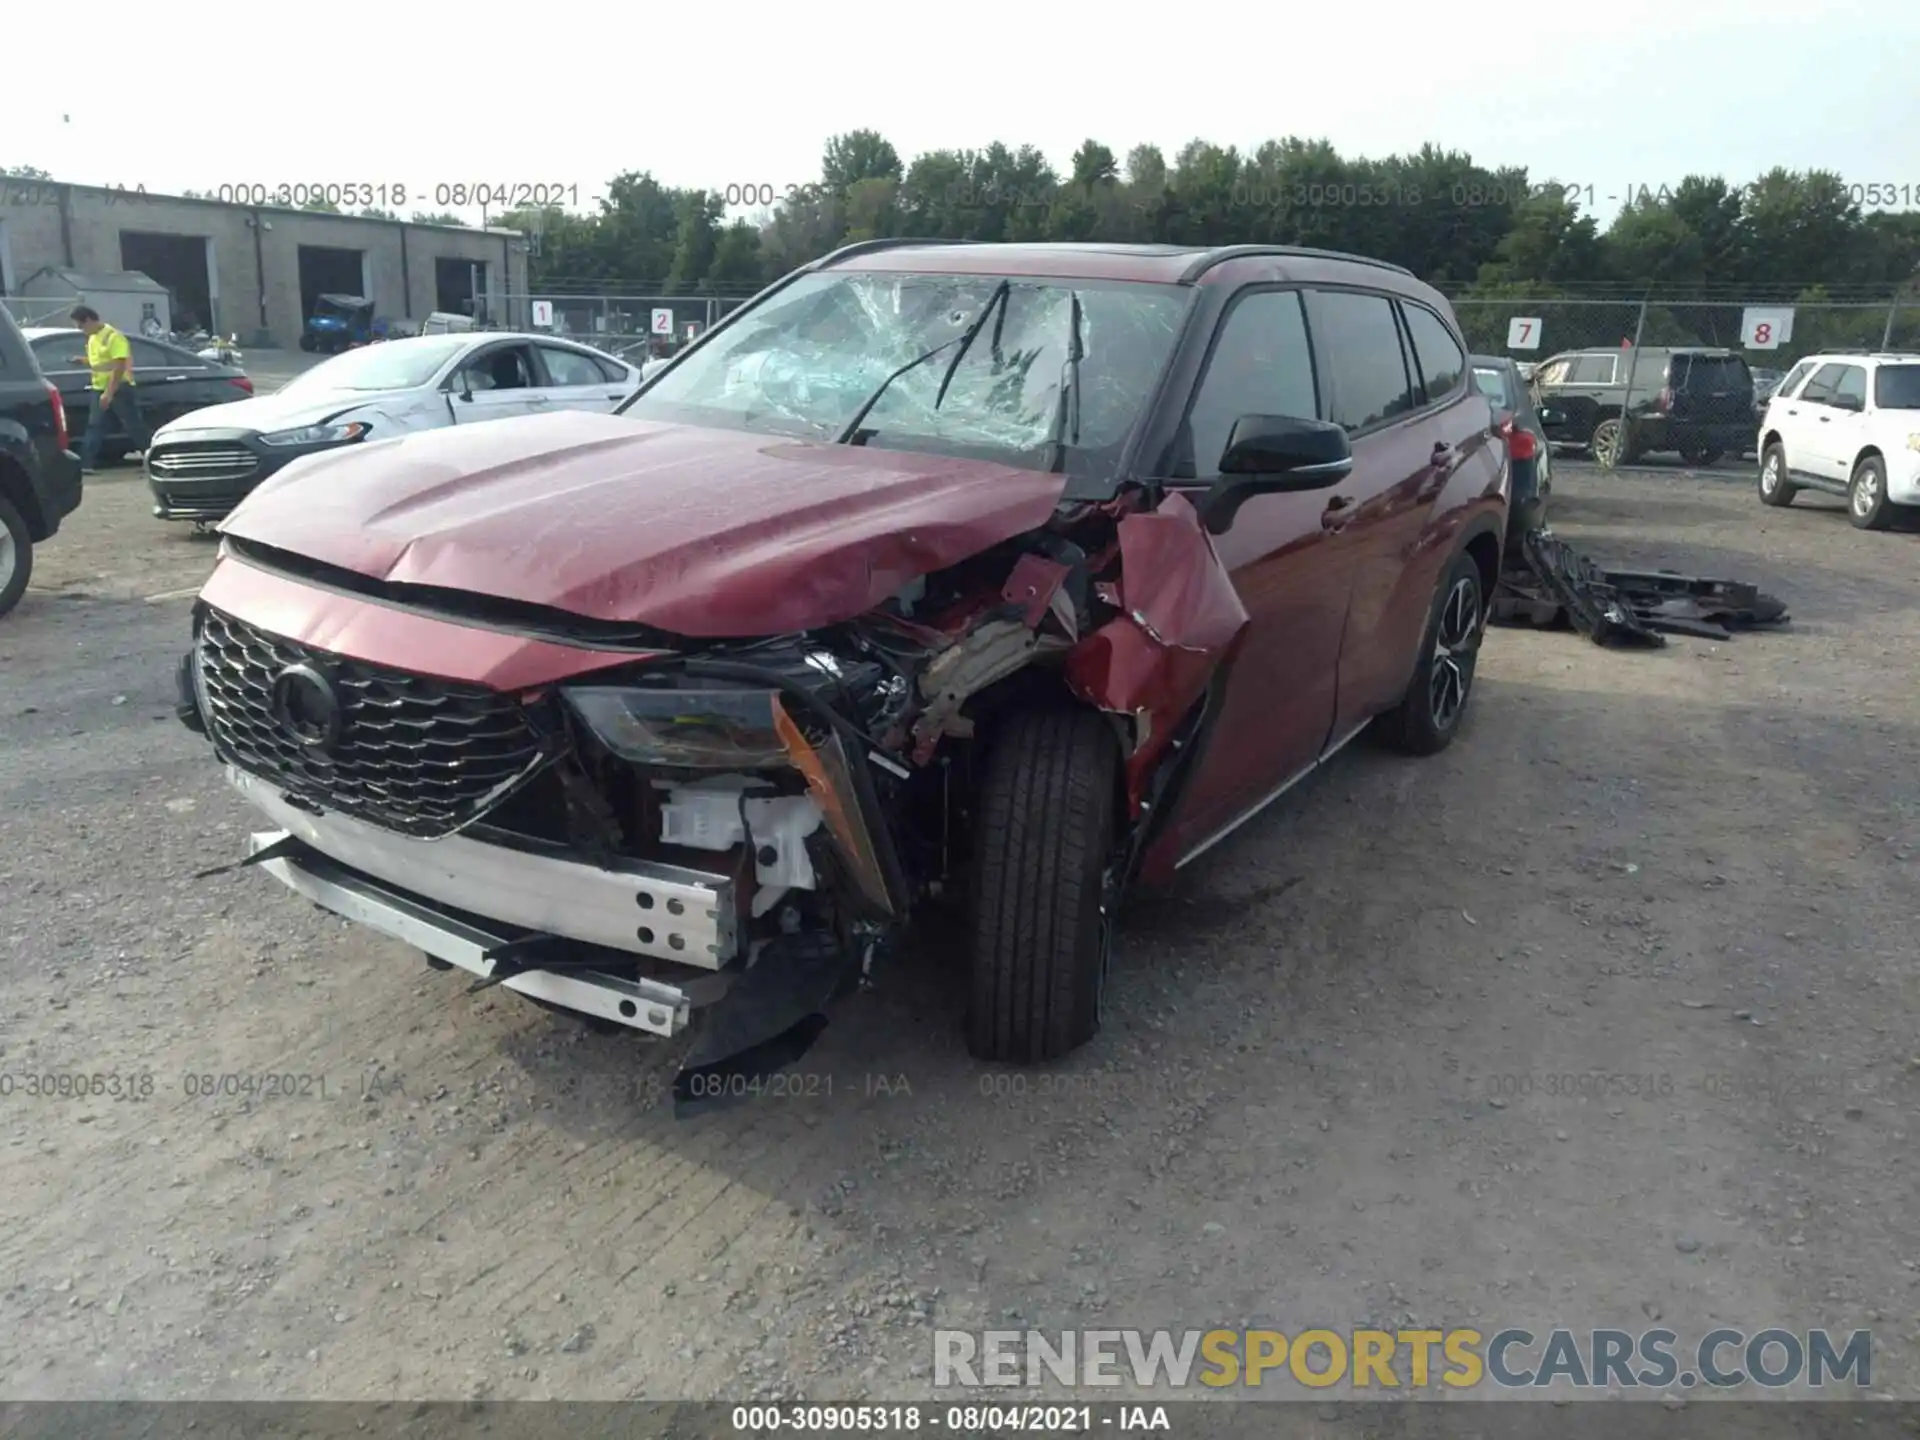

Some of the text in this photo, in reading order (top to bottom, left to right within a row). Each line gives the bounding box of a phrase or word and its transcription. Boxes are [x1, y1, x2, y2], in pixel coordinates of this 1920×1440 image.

[538, 305, 546, 321] 1
[657, 313, 667, 330] 2
[1518, 324, 1532, 344] 7
[1754, 323, 1771, 344] 8
